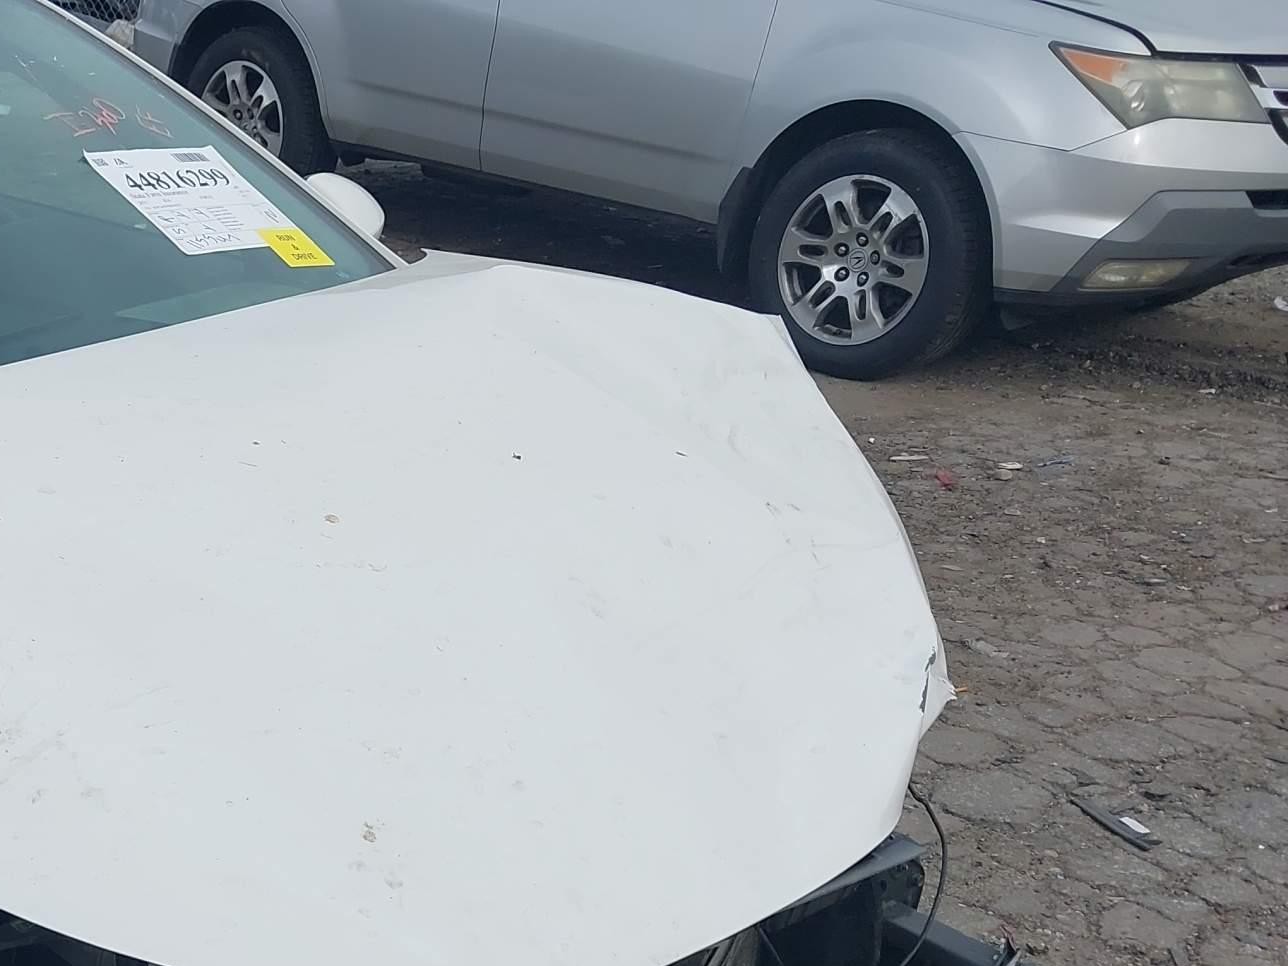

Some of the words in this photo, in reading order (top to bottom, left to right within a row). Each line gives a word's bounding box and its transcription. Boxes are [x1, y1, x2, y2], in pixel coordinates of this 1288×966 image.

[124, 167, 230, 191] 44816299
[275, 234, 296, 242] RUN
[291, 252, 318, 261] DRIVE
